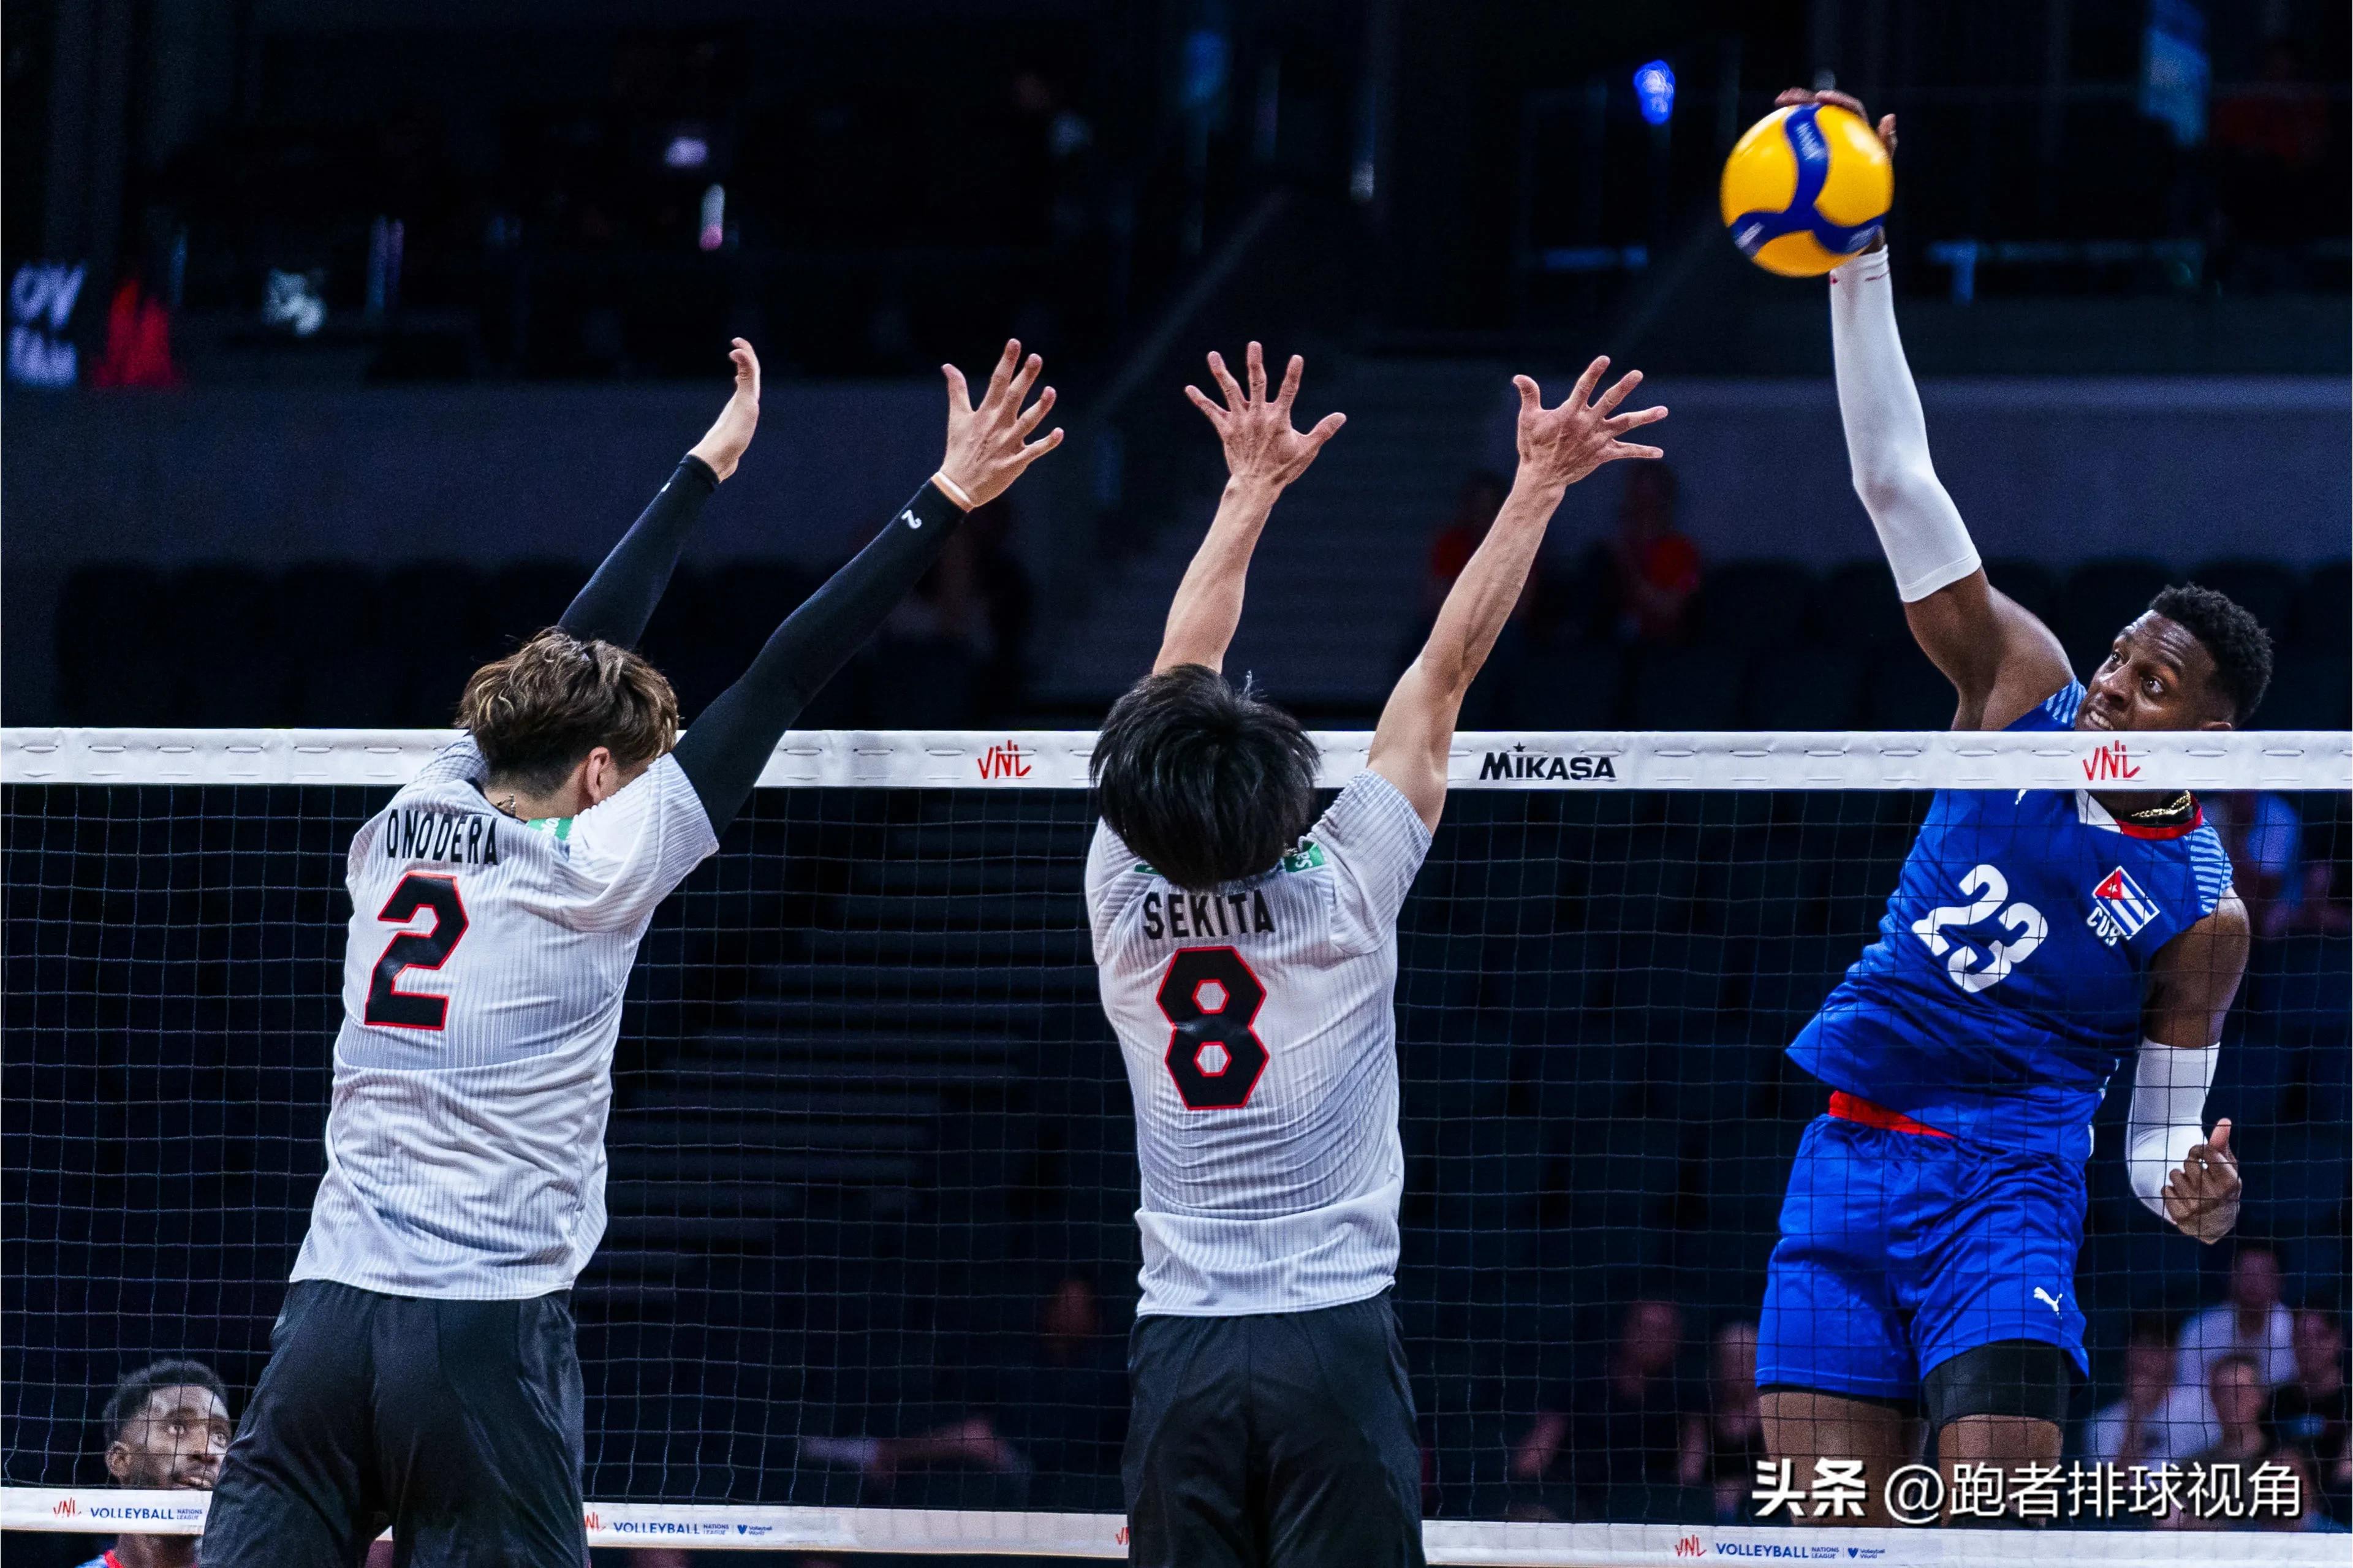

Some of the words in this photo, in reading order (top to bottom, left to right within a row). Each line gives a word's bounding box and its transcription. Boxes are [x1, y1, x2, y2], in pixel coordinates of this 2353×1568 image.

[977, 740, 1032, 779] VNL
[1479, 751, 1616, 781] MIKASA
[2083, 740, 2141, 781] VNL
[387, 809, 499, 865] ONODERA
[1143, 890, 1276, 939] SEKITA
[1911, 864, 2048, 993] 23
[2086, 906, 2122, 947] CUB
[365, 871, 469, 1031] 2
[1156, 945, 1270, 1110] 8
[90, 1507, 175, 1520] VOLLEYBALL
[613, 1522, 700, 1534] VOLLEYBALL
[1674, 1534, 1707, 1557] VNL
[1716, 1543, 1809, 1558] VOLLEYBALL
